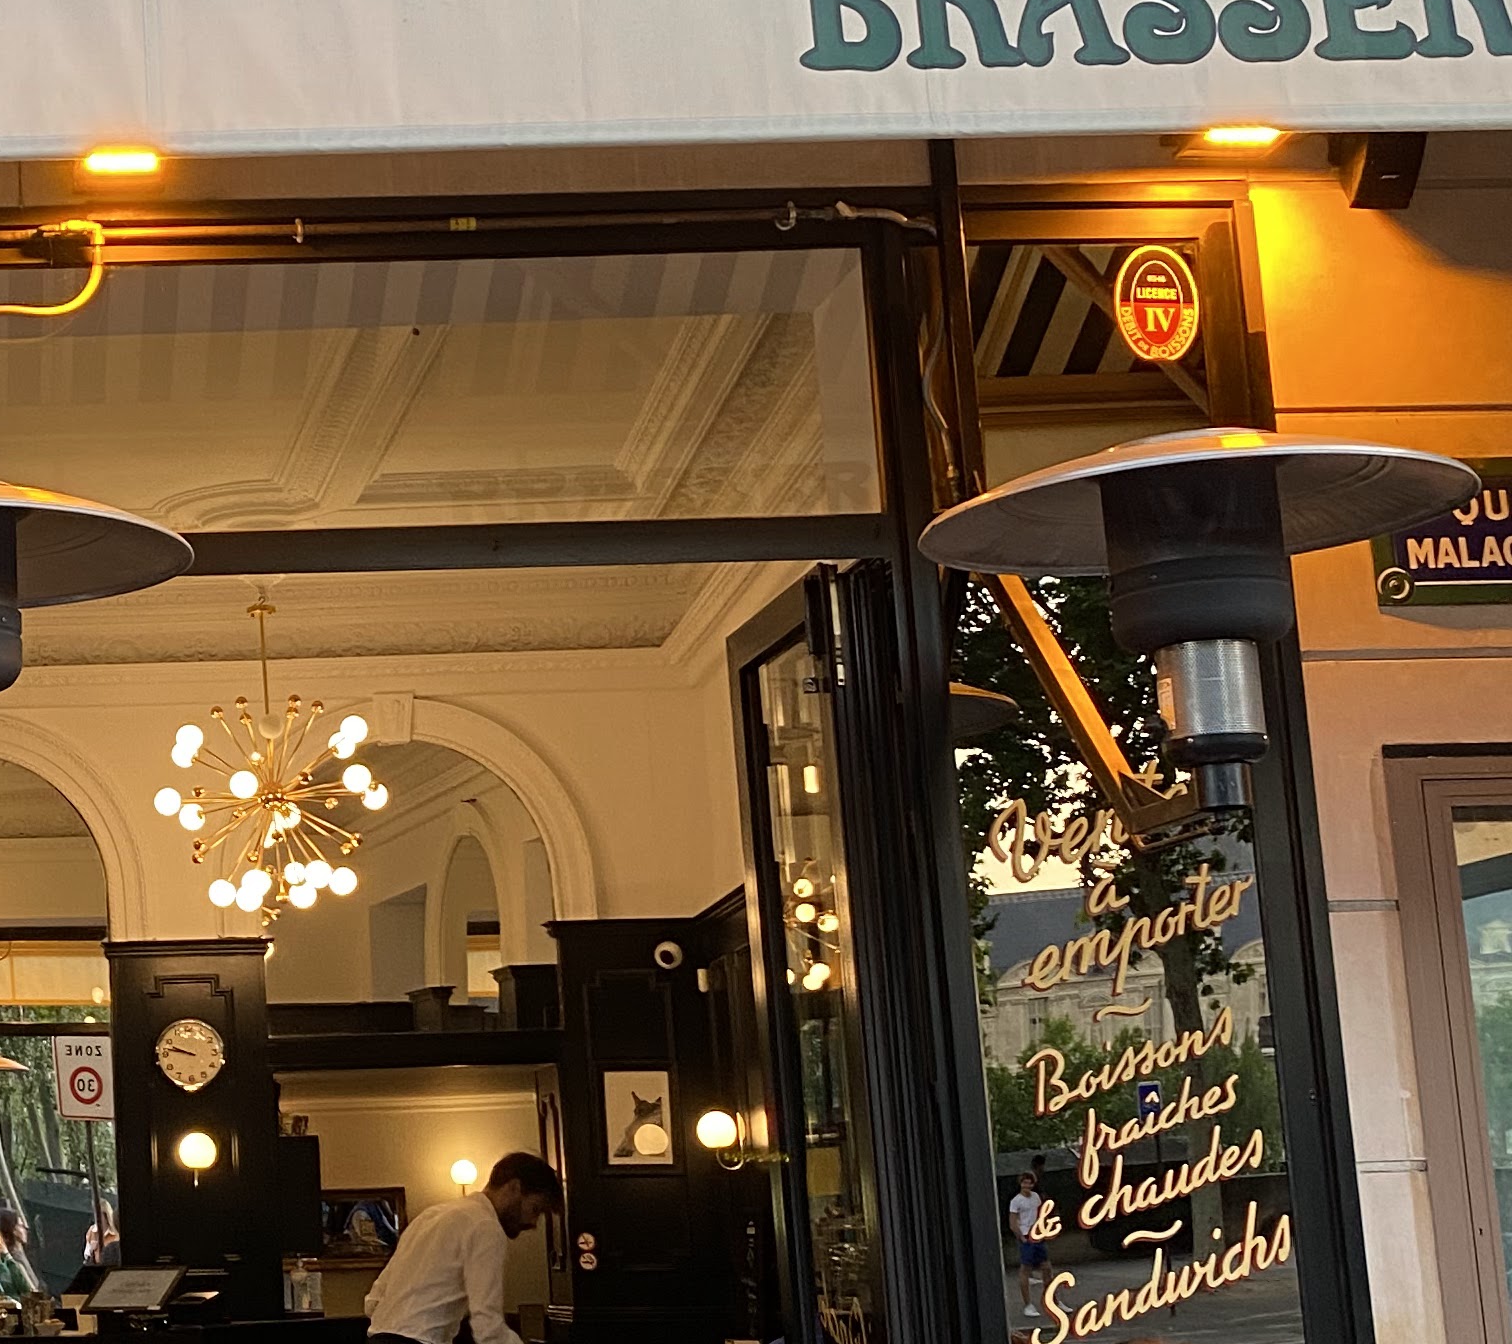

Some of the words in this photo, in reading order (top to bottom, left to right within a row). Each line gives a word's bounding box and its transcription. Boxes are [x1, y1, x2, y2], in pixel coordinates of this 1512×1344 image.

[1135, 287, 1178, 300] LICENCE
[1144, 307, 1176, 332] IV
[1149, 307, 1195, 358] BOISSONS
[1022, 862, 1254, 997] emporter
[1026, 1006, 1233, 1118] Boissons
[1029, 1199, 1063, 1242] &
[1080, 1124, 1264, 1230] chaudes
[1079, 1073, 1239, 1189] fraîches
